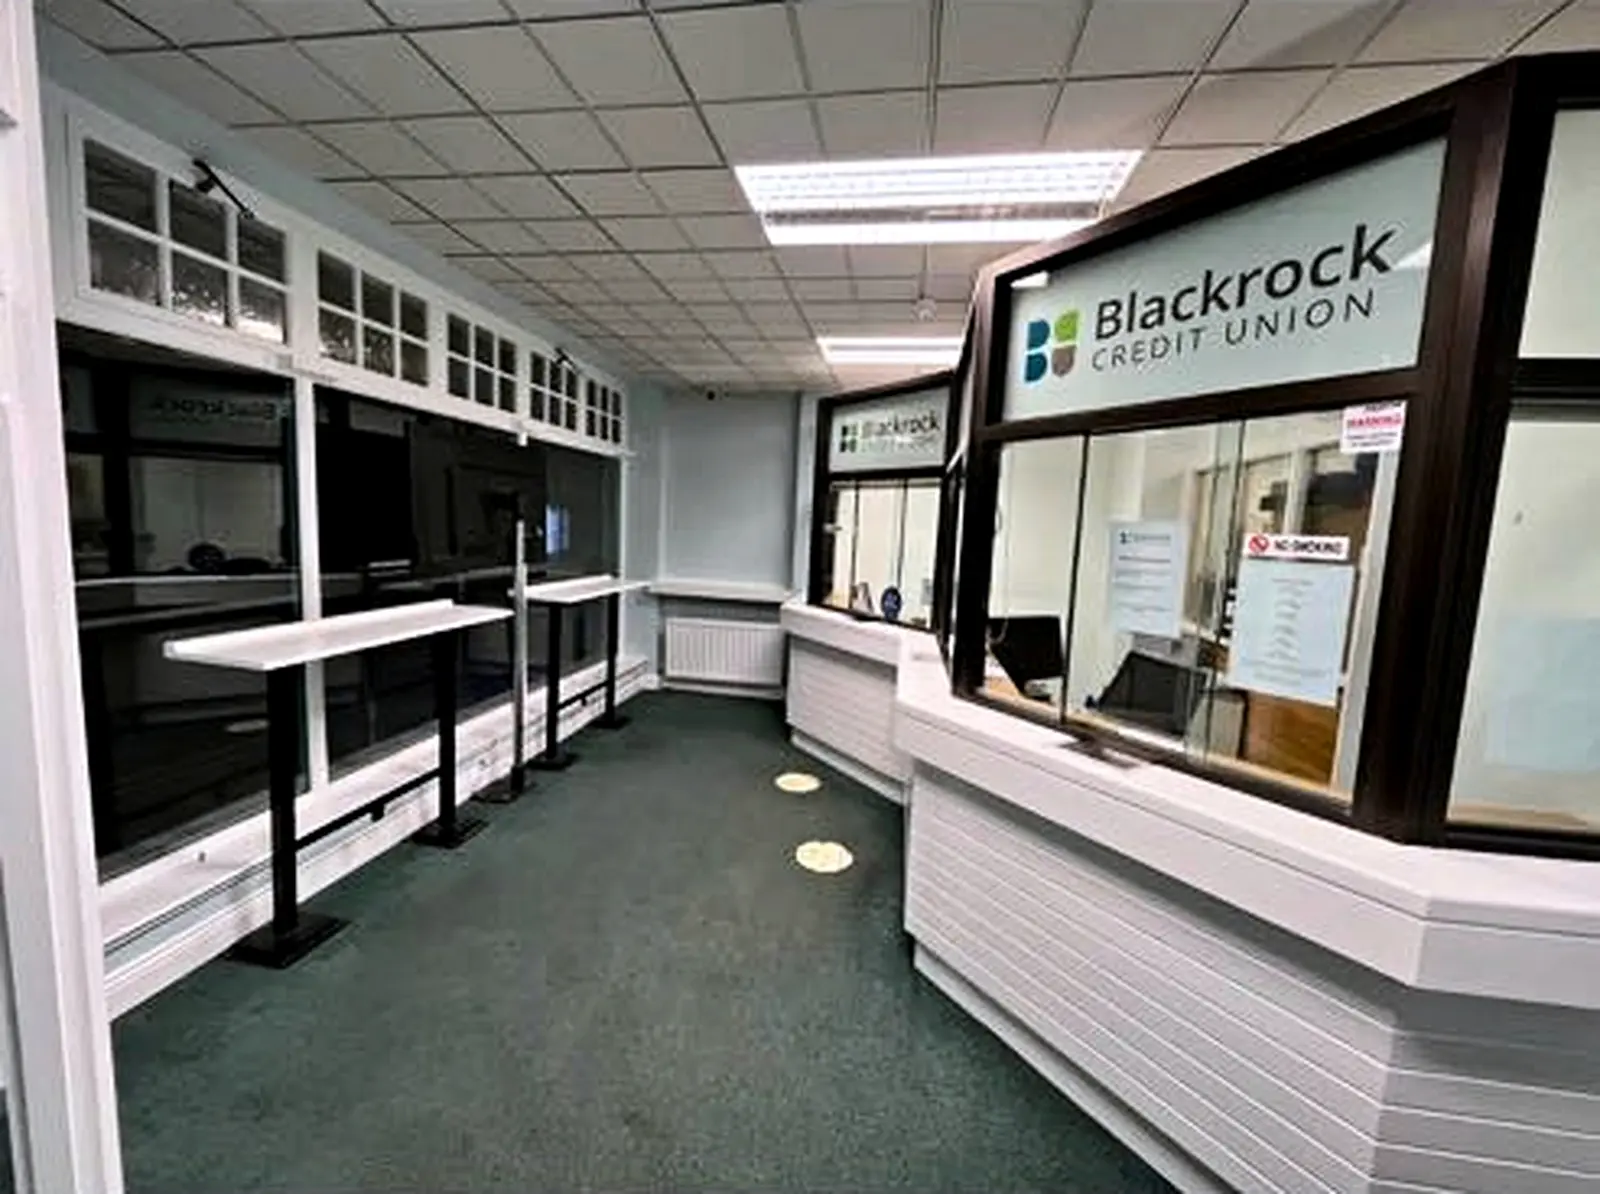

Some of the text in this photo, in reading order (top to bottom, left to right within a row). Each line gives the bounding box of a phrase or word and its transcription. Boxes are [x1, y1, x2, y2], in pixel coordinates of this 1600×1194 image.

[1091, 288, 1374, 372] CREDIT UNION
[1095, 224, 1395, 340] Blackrock
